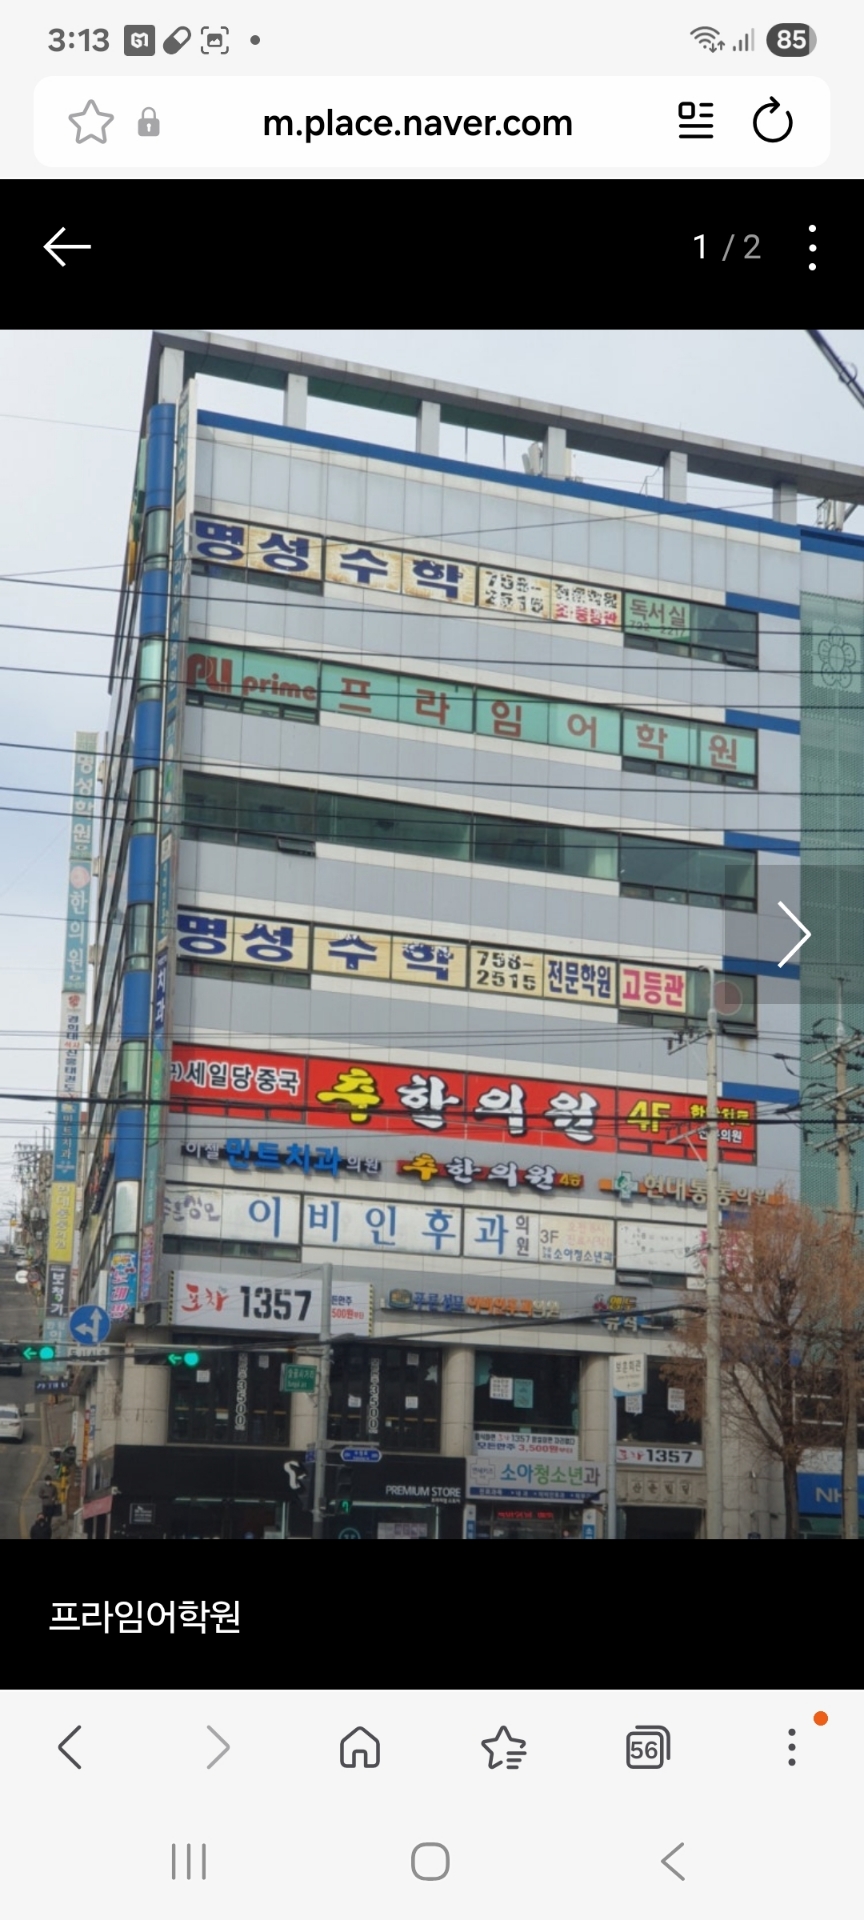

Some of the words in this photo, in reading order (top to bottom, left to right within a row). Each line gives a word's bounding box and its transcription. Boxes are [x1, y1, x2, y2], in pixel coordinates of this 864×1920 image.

[195, 520, 463, 599] 명성수학
[630, 599, 686, 628] 독서실
[242, 673, 317, 700] prime
[338, 677, 737, 770] 프라임어학원
[68, 890, 88, 973] 한의원
[177, 914, 454, 981] 명성수학
[548, 960, 611, 999] 전문학원
[622, 968, 684, 1007] 고등관
[627, 1100, 671, 1132] 4F
[249, 1196, 509, 1255] 이비인후과
[515, 1214, 530, 1257] 의원
[540, 1229, 559, 1244] 3F
[50, 1272, 65, 1316] 보청기
[240, 1286, 312, 1321] 1357
[500, 1463, 600, 1486] 소아청소년과
[646, 1449, 693, 1464] 1357
[386, 1485, 430, 1497] PREMIUM
[431, 1486, 462, 1498] STORE
